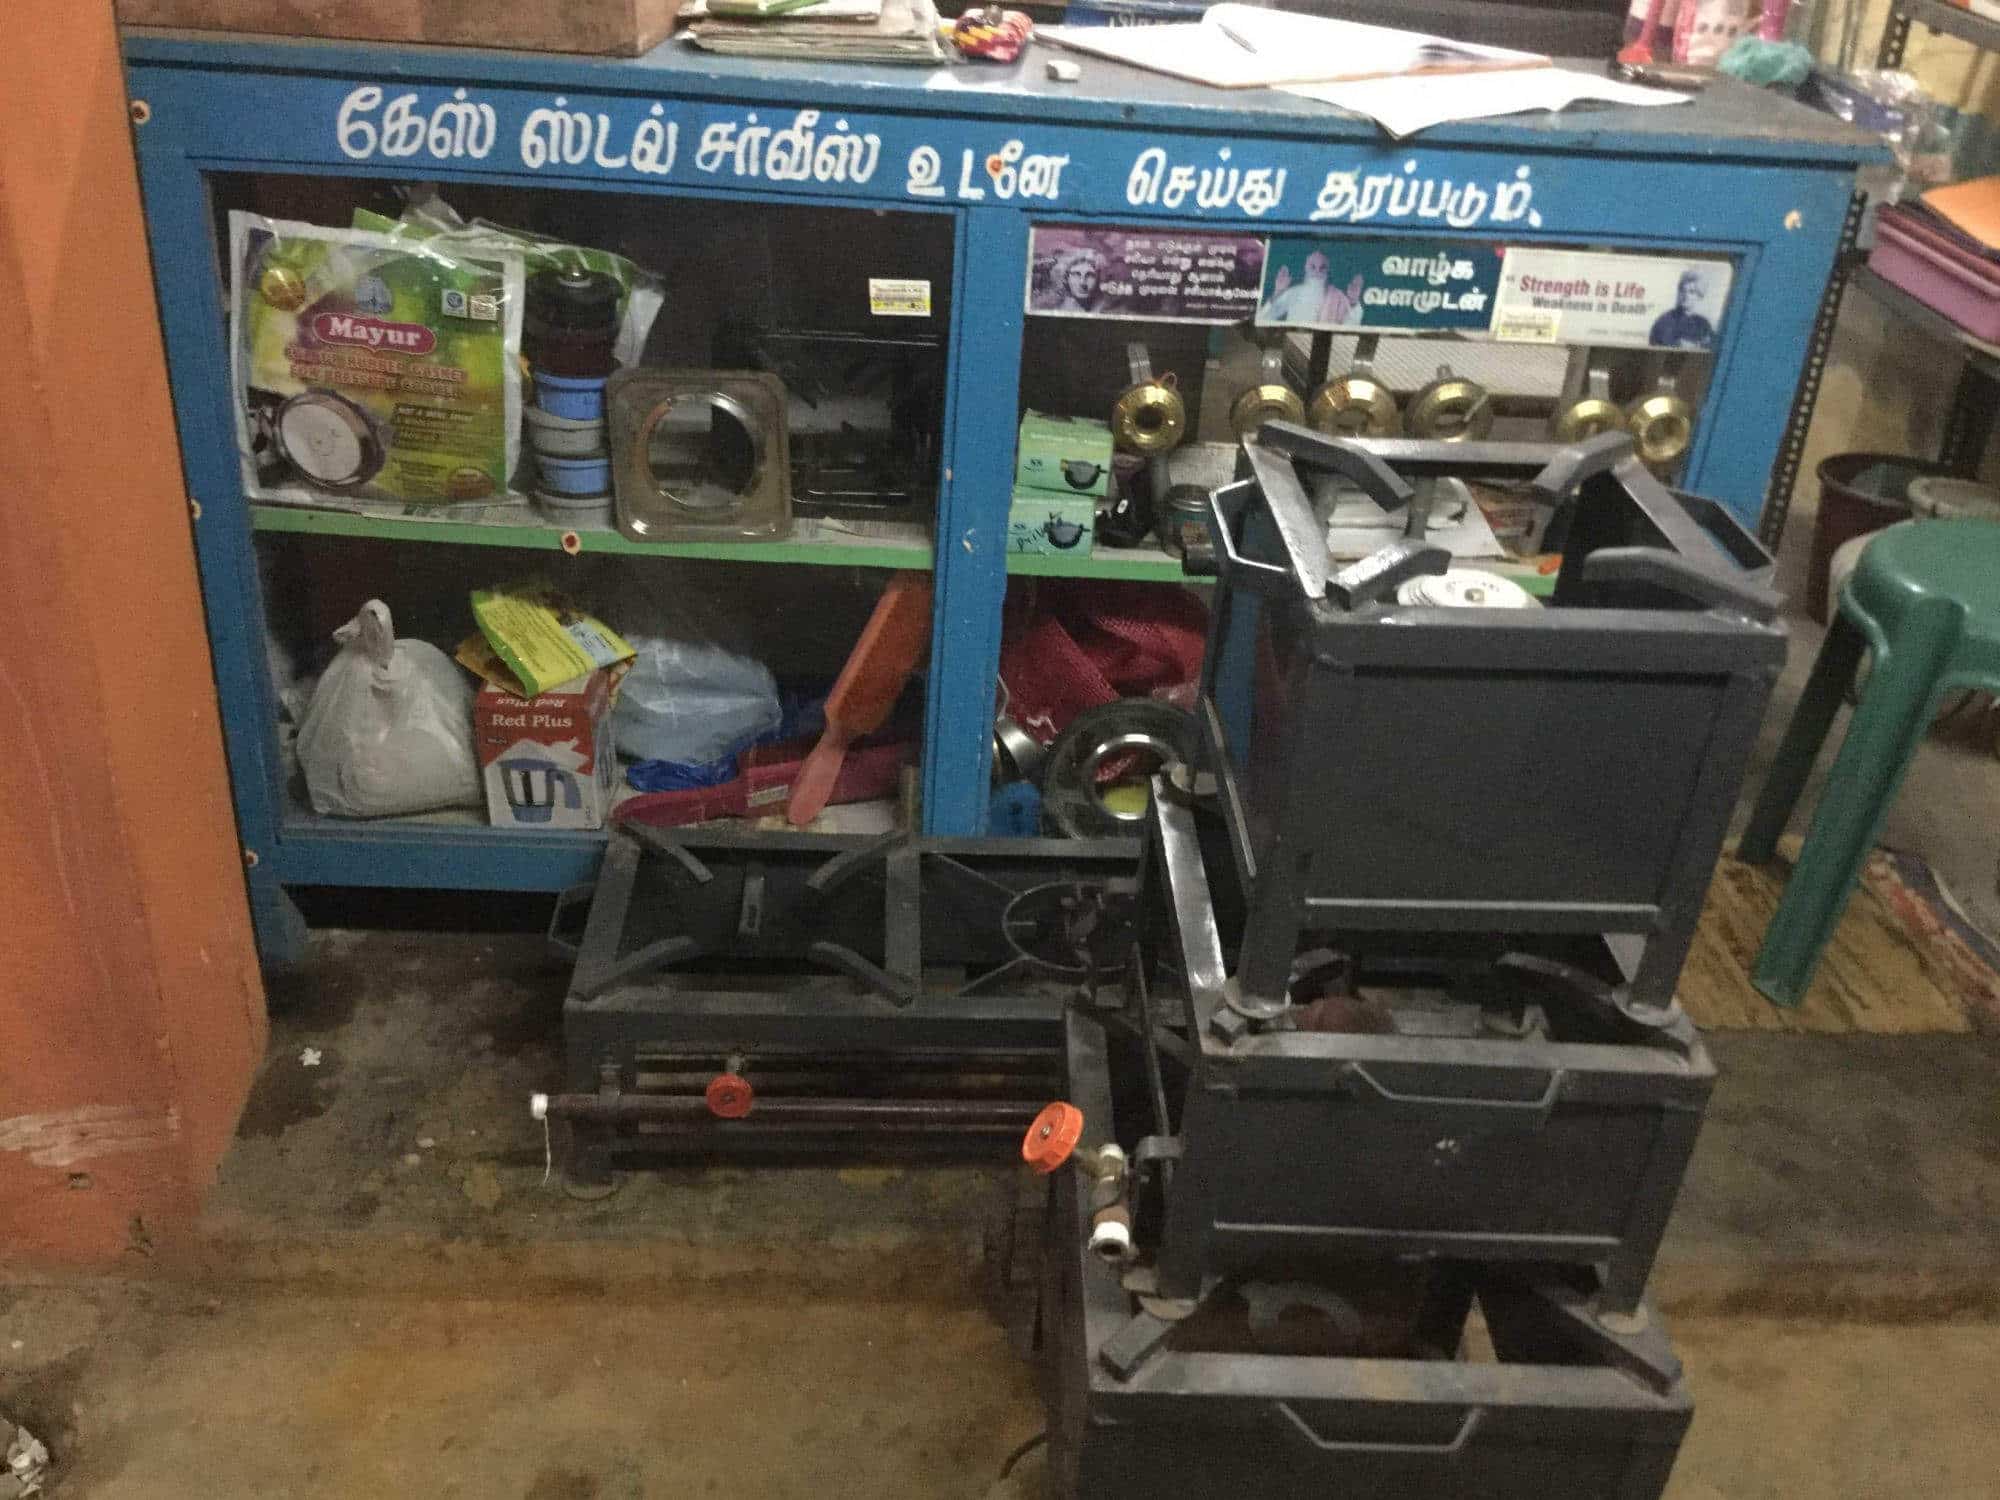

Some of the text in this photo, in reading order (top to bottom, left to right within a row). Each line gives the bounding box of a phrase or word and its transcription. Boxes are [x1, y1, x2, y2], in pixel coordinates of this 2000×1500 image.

[337, 86, 497, 159] கேஸ்
[521, 96, 679, 174] ஸ்டவ்
[695, 110, 881, 184] சர்வீஸ்
[1126, 147, 1287, 216] செய்து
[1382, 252, 1474, 286] வாழ்க
[1363, 287, 1487, 314] வளமுடன்
[1596, 280, 1608, 297] is
[1613, 282, 1646, 299] Life
[1532, 296, 1592, 312] Weakness
[328, 317, 420, 346] Mayur
[492, 714, 572, 728] Red Plus
